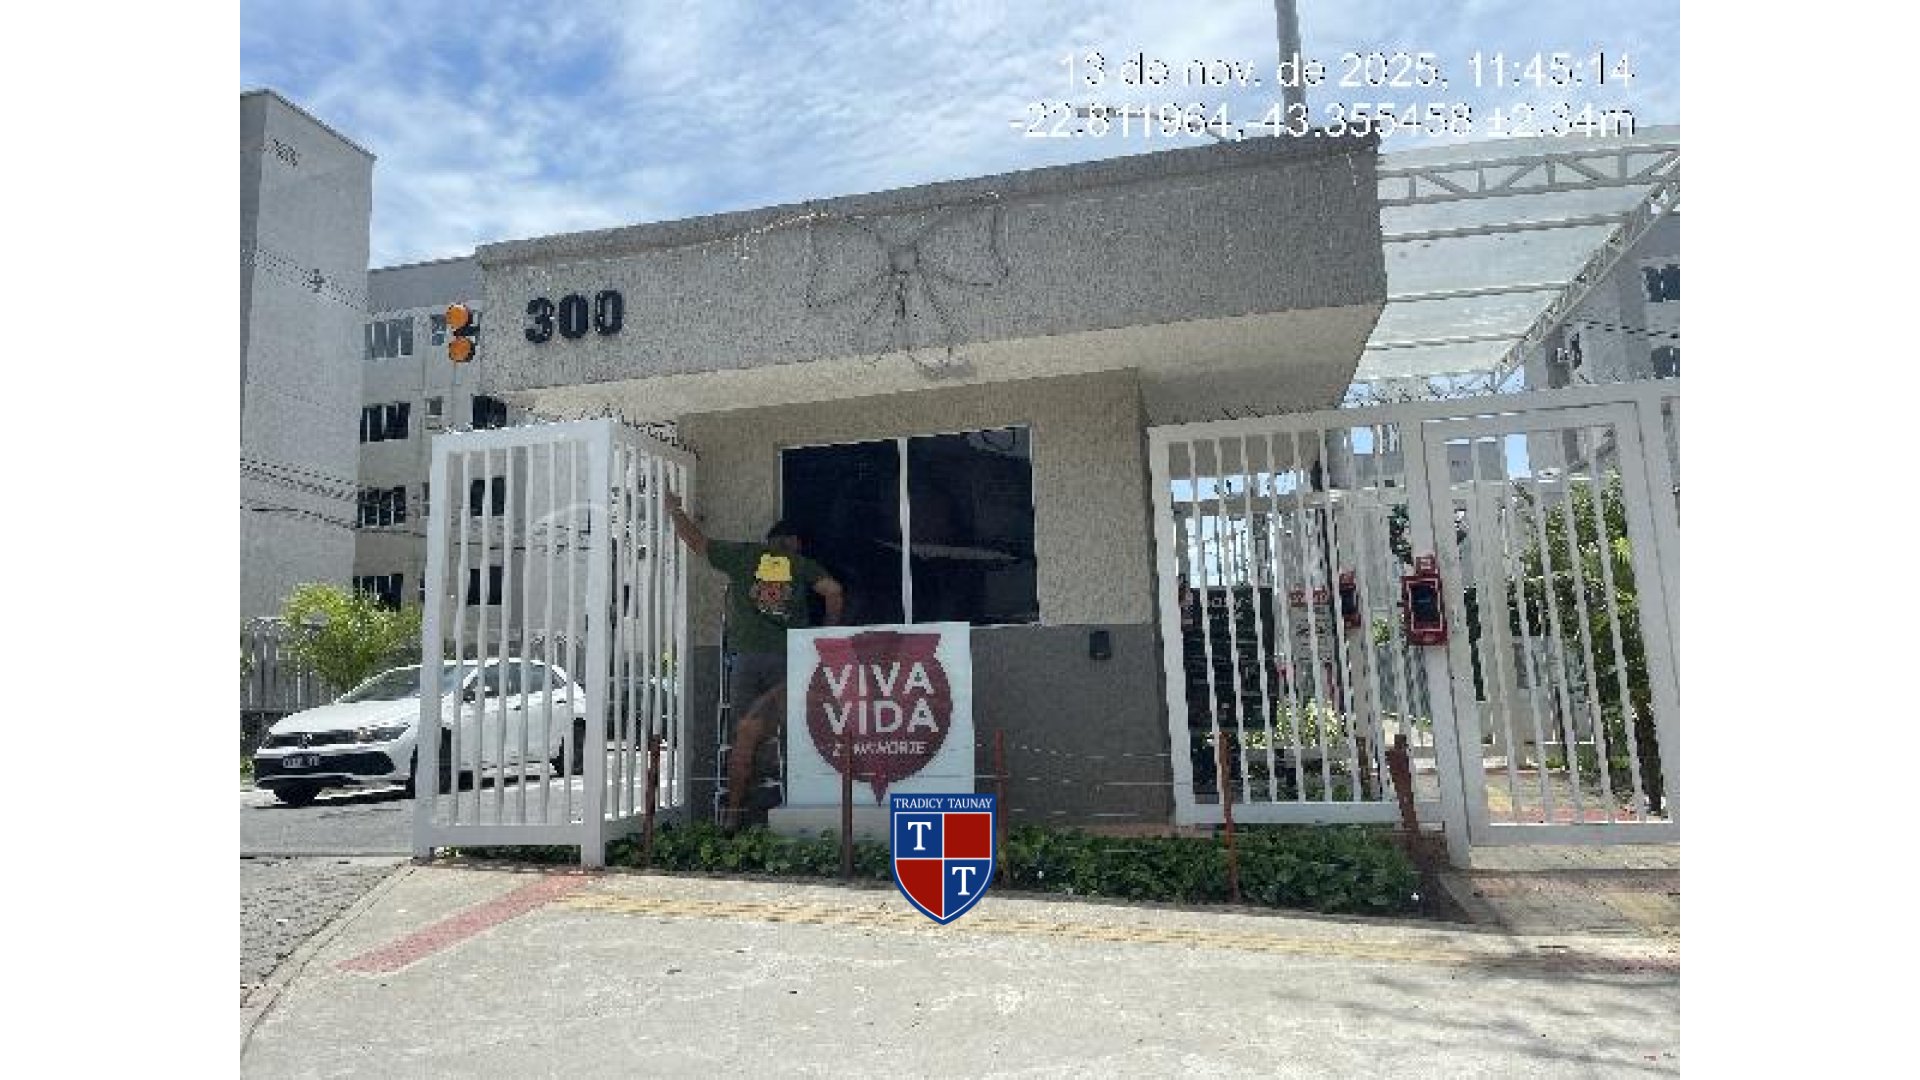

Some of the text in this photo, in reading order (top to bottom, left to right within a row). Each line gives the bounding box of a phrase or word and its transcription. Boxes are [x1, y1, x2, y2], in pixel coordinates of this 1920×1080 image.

[525, 289, 625, 344] 300
[823, 662, 935, 697] VIVA
[823, 697, 940, 735] VIDA
